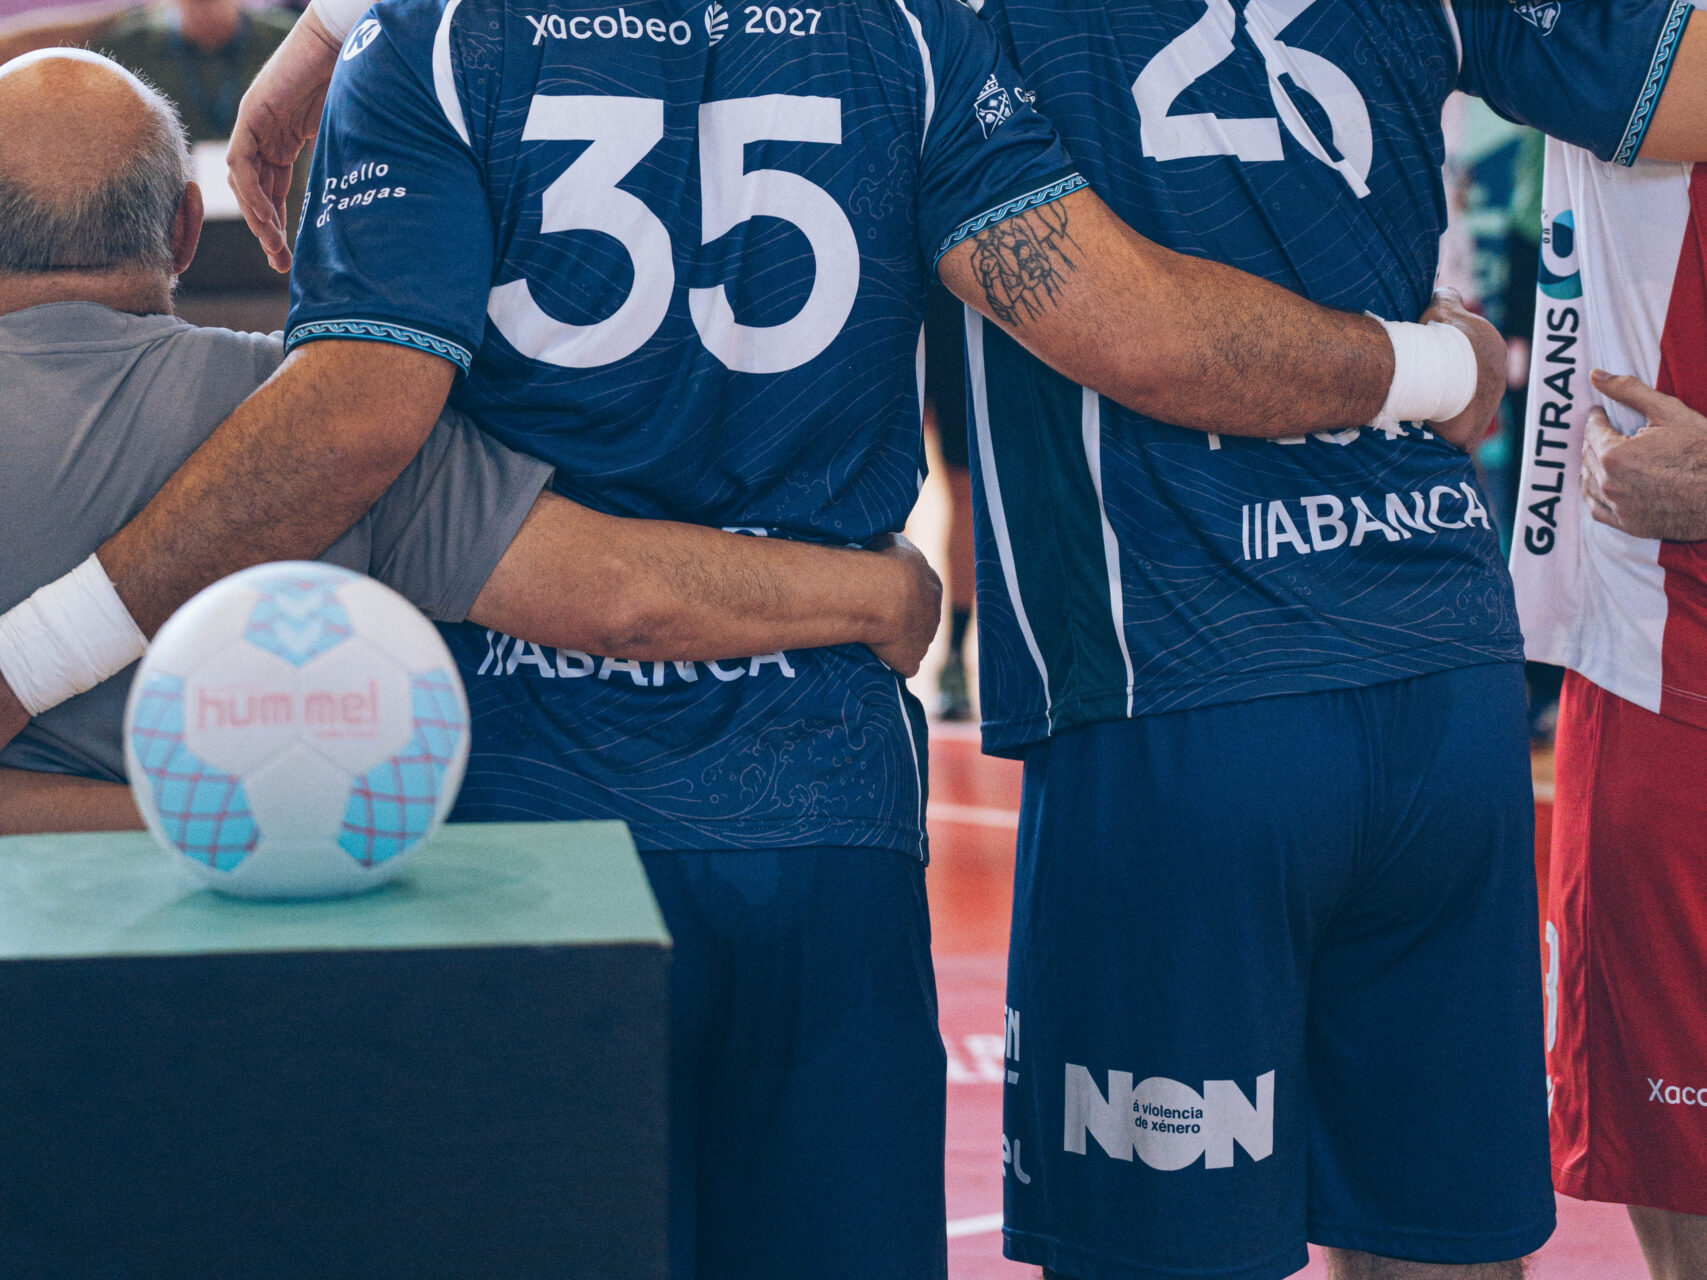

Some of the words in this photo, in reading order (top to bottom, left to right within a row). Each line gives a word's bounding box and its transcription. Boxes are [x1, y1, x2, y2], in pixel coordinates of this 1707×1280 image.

[743, 5, 822, 37] 2027
[486, 94, 861, 375] 35
[1524, 307, 1580, 556] GALITRANS
[198, 678, 379, 732] hummel
[1063, 1062, 1276, 1172] NON
[1132, 1099, 1140, 1113] á
[1142, 1102, 1204, 1120] violencia
[1134, 1115, 1149, 1130] de
[1151, 1119, 1201, 1134] xénero
